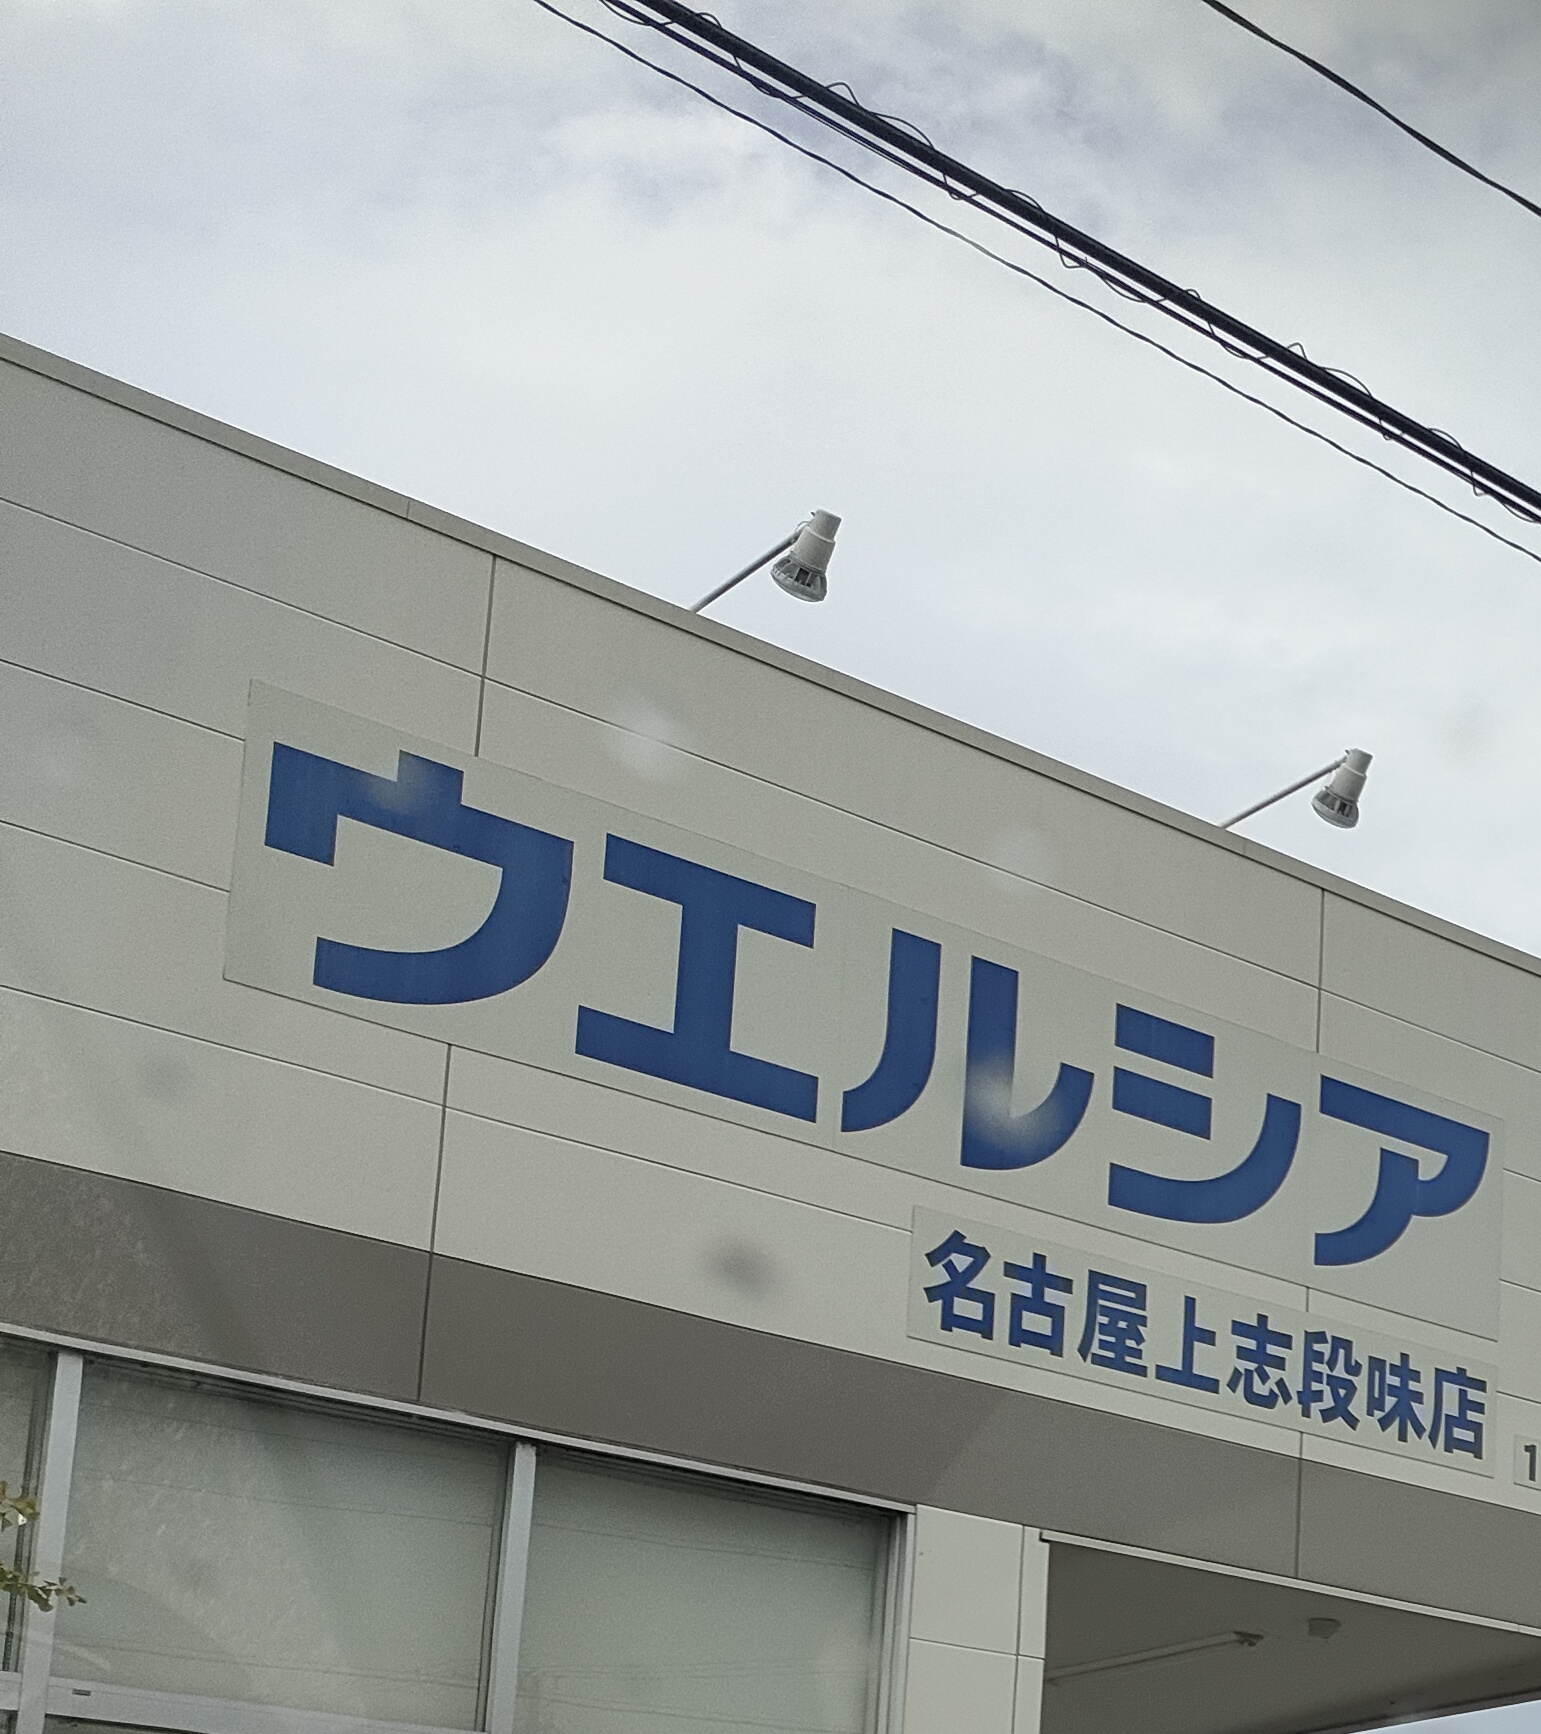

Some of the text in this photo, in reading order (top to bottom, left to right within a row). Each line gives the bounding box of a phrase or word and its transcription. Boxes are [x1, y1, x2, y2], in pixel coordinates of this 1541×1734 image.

[265, 742, 1490, 1266] ウエルシア
[922, 1229, 1488, 1461] 名古屋上志段味店
